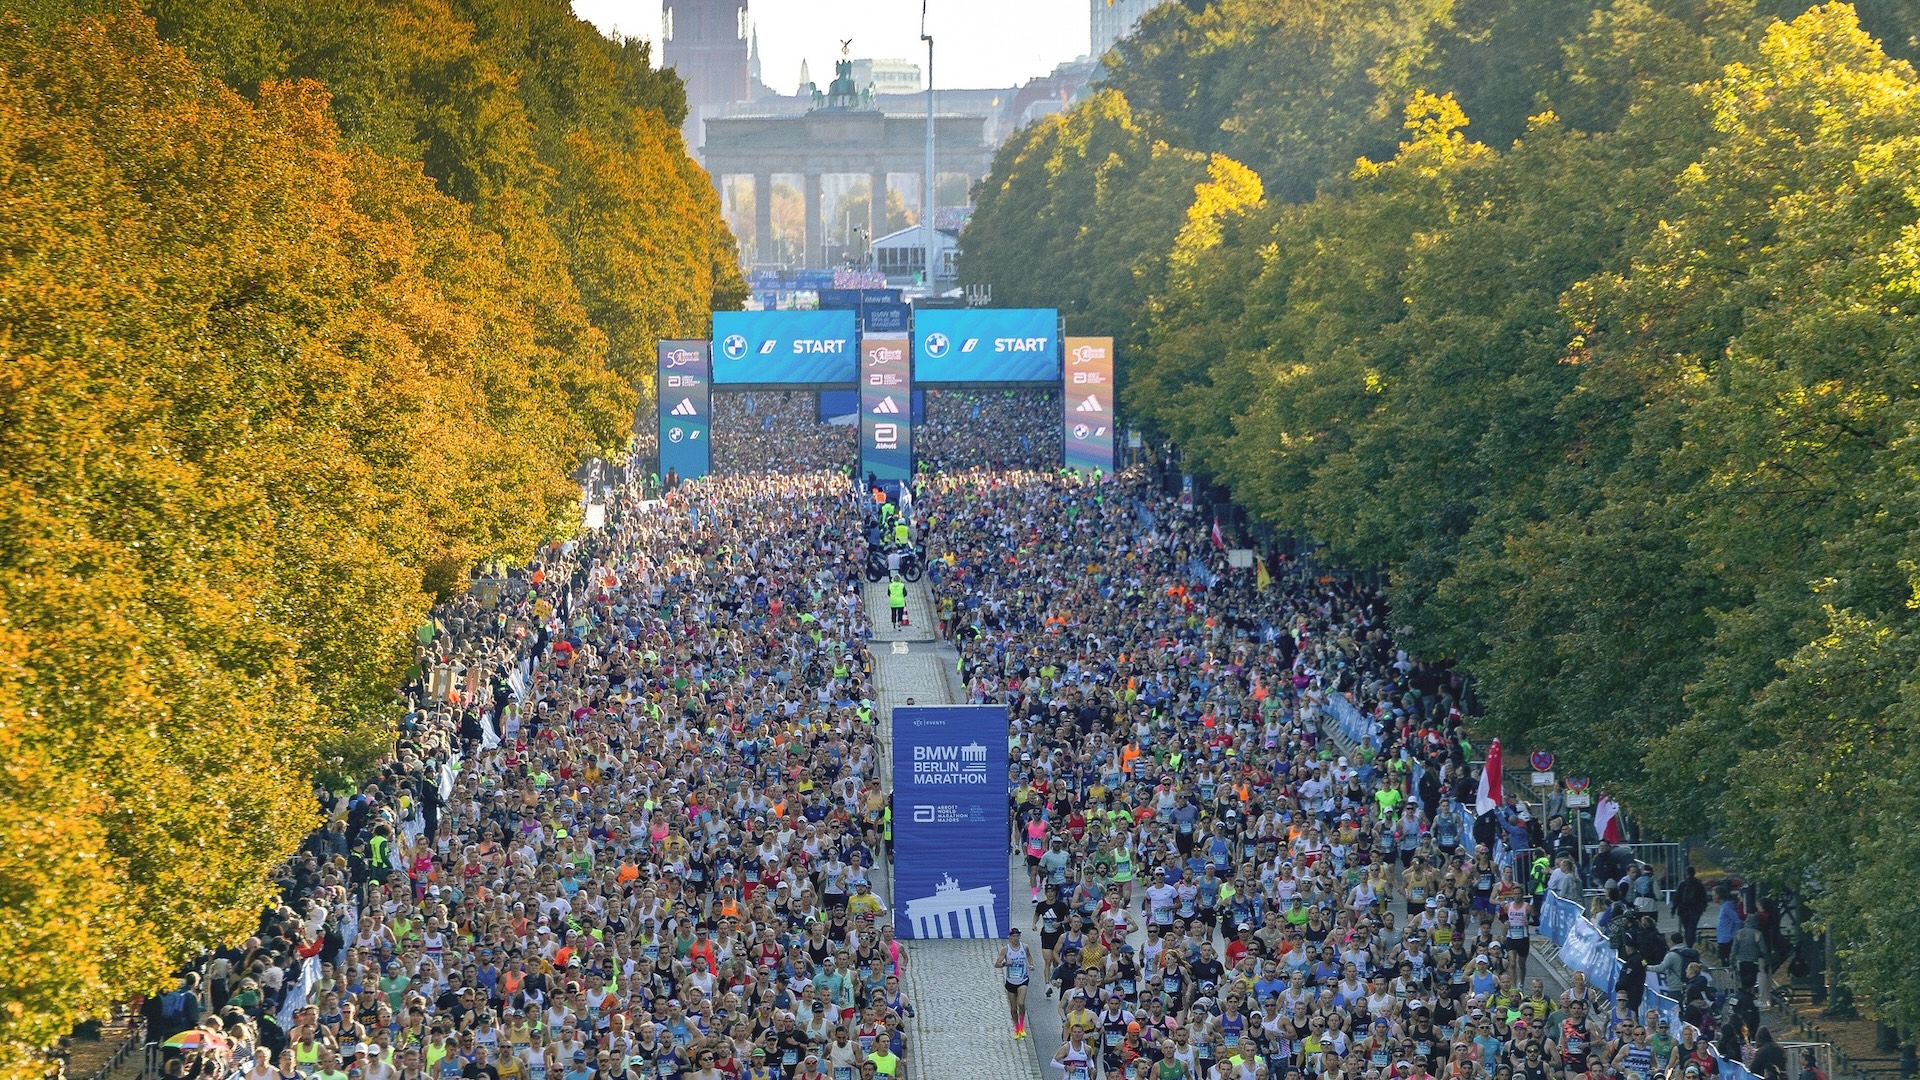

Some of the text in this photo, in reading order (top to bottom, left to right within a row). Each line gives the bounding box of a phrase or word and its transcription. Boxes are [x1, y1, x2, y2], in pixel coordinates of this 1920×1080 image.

[792, 339, 846, 354] START
[994, 337, 1048, 353] START
[914, 746, 958, 760] BMW
[914, 761, 959, 772] BERLIN
[914, 773, 987, 784] MARATHON
